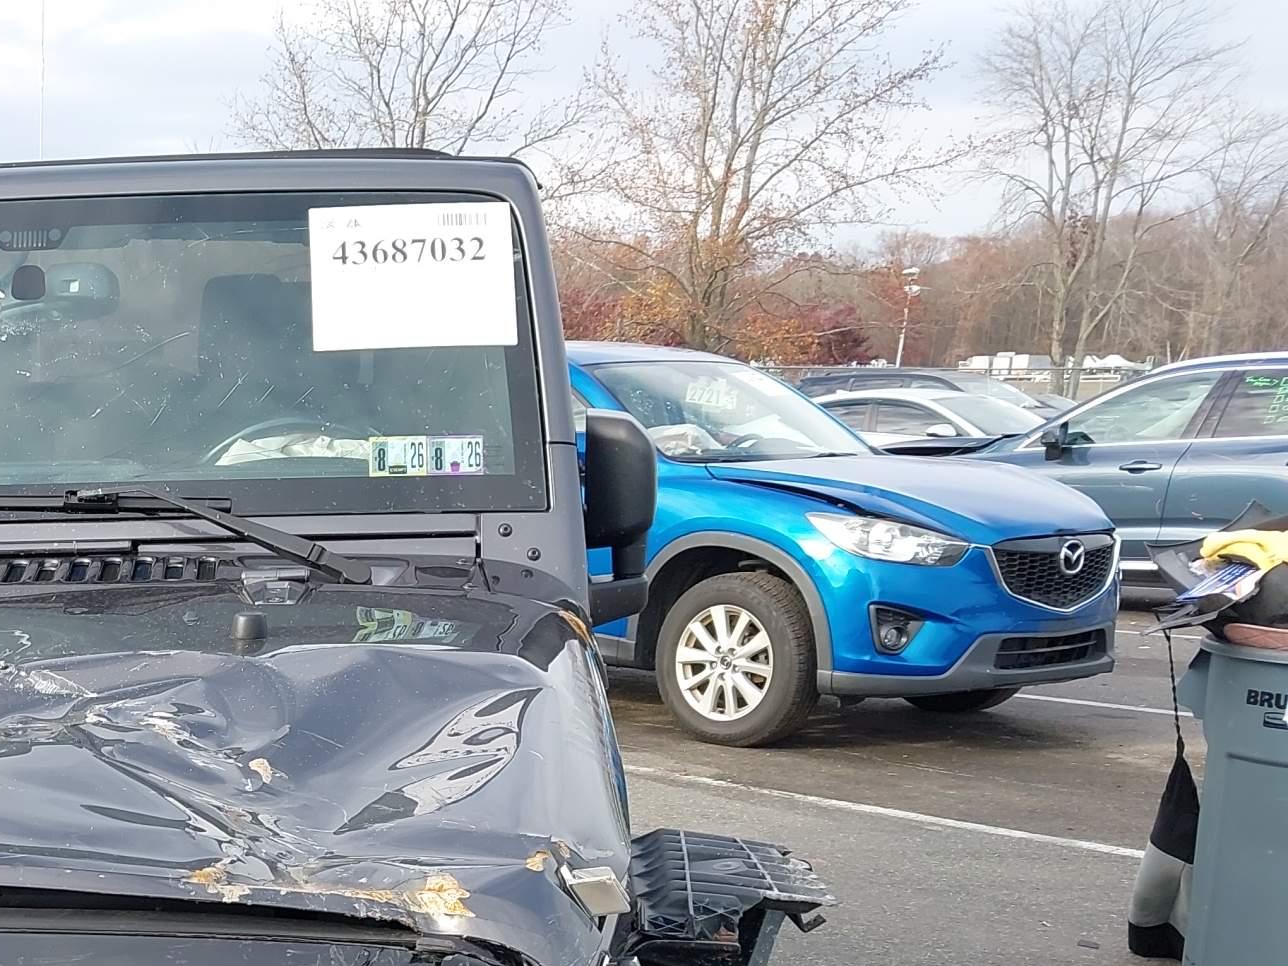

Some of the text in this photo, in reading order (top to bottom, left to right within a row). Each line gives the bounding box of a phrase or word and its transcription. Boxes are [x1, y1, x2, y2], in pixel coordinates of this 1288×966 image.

[332, 236, 487, 265] 43687032
[410, 441, 424, 469] 26
[467, 440, 481, 468] 26
